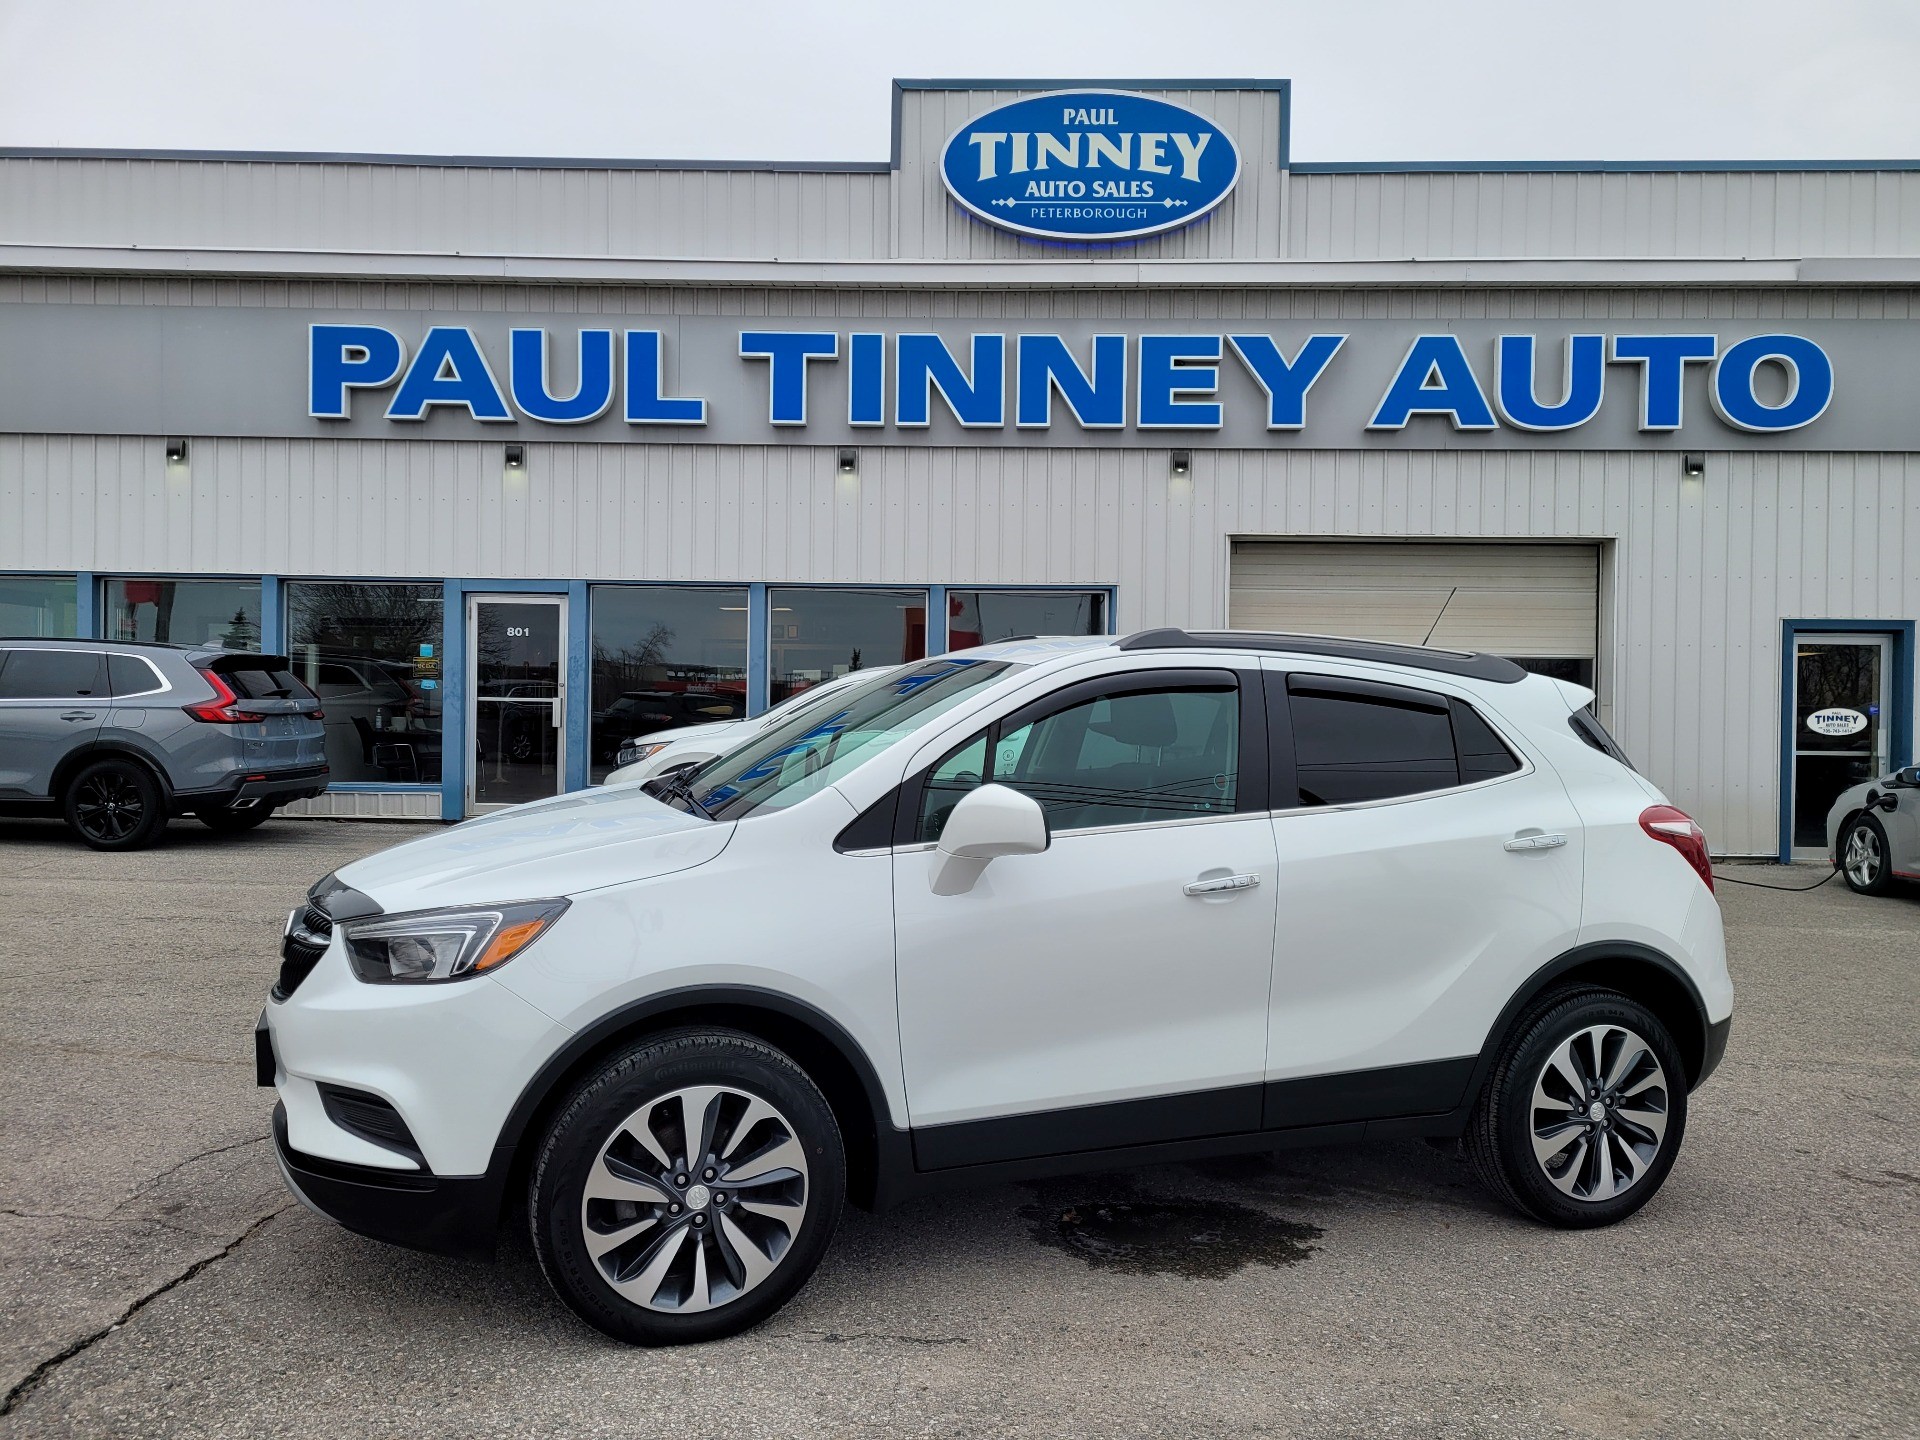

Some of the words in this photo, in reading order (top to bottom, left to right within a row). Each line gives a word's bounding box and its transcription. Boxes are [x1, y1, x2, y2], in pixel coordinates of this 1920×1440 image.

[1063, 108, 1119, 126] PAUL
[968, 132, 1213, 183] TINNEY
[1024, 181, 1086, 198] AUTO
[1092, 180, 1154, 198] SALES
[1031, 207, 1148, 219] PETERBOROUGH
[308, 323, 707, 426] PAUL
[738, 330, 1350, 431] TINNEY
[1364, 332, 1835, 433] AUTO
[506, 627, 529, 637] 801
[1814, 715, 1859, 724] TINNEY
